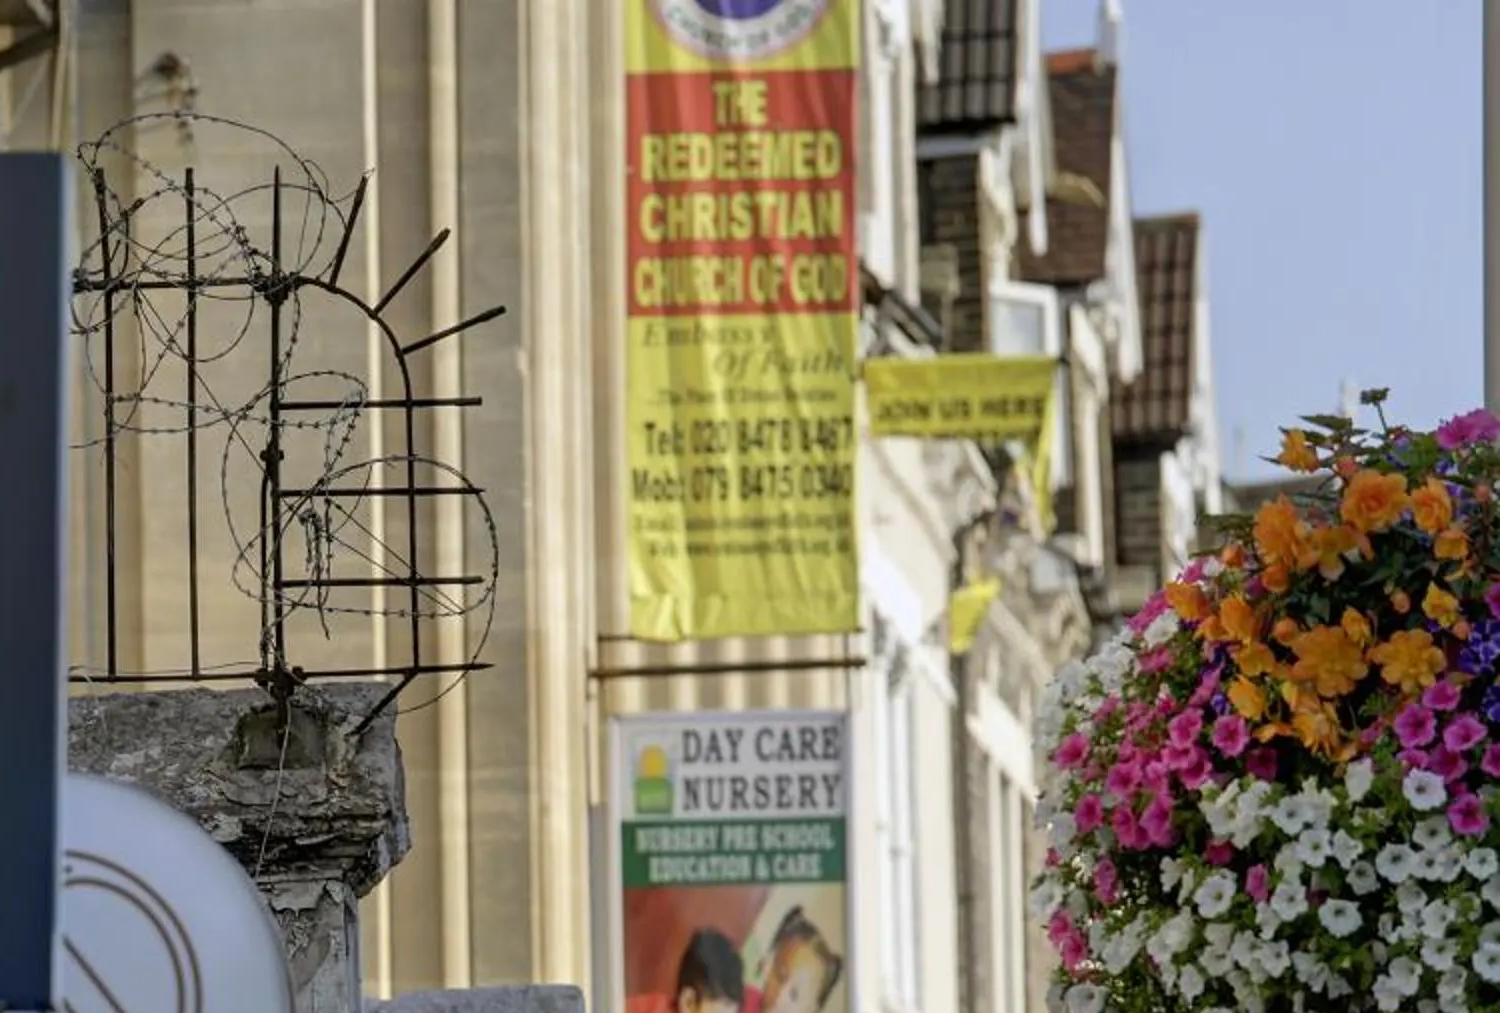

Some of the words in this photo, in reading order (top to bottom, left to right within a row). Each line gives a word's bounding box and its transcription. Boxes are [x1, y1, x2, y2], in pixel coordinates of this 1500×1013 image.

[713, 80, 767, 126] THE
[641, 130, 841, 183] REDEEMED
[640, 190, 843, 243] CHRISTIAN
[634, 256, 744, 307] CHURCH
[750, 253, 788, 303] OF
[790, 252, 847, 303] GOD
[644, 420, 684, 455] Tel:
[682, 728, 744, 764] DAY
[756, 726, 841, 762] CARE
[682, 774, 841, 811] NURSERY
[636, 825, 718, 853] NURSERY
[722, 824, 758, 851] PRE
[762, 822, 835, 850] SCHOOL
[649, 855, 750, 882] EDUCATION
[754, 855, 770, 880] &
[773, 854, 824, 879] CARE
